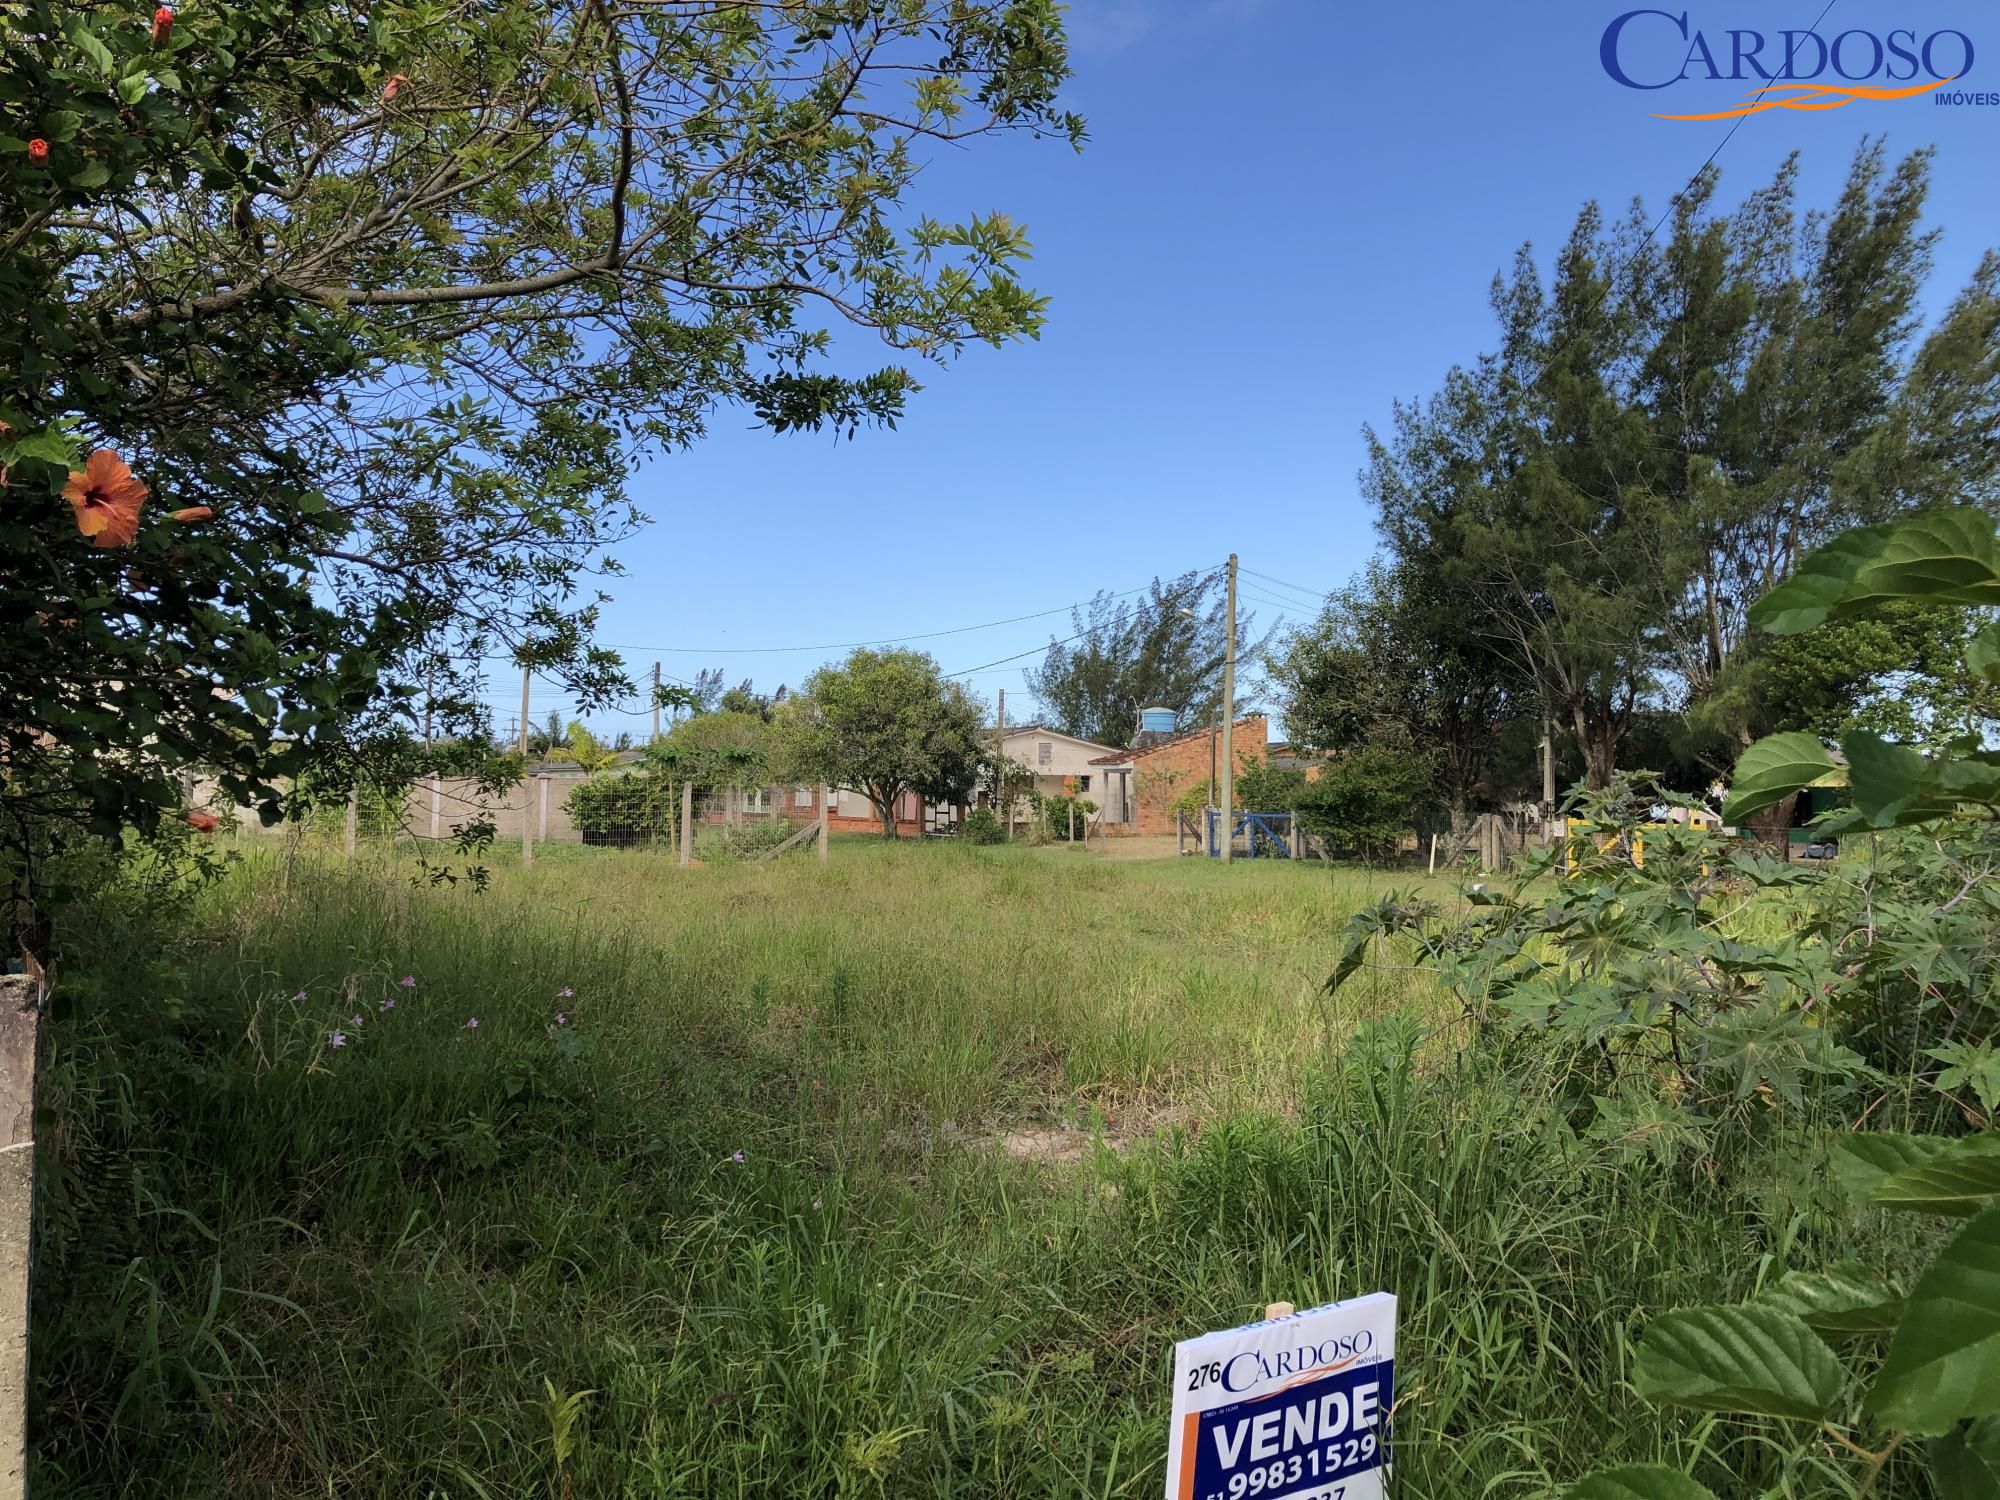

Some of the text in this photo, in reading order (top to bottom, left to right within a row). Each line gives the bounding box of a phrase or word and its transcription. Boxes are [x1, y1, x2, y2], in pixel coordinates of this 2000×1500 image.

[1187, 1361, 1221, 1392] 276
[1220, 1329, 1373, 1393] CARDOSO
[1212, 1380, 1380, 1471] VENDE
